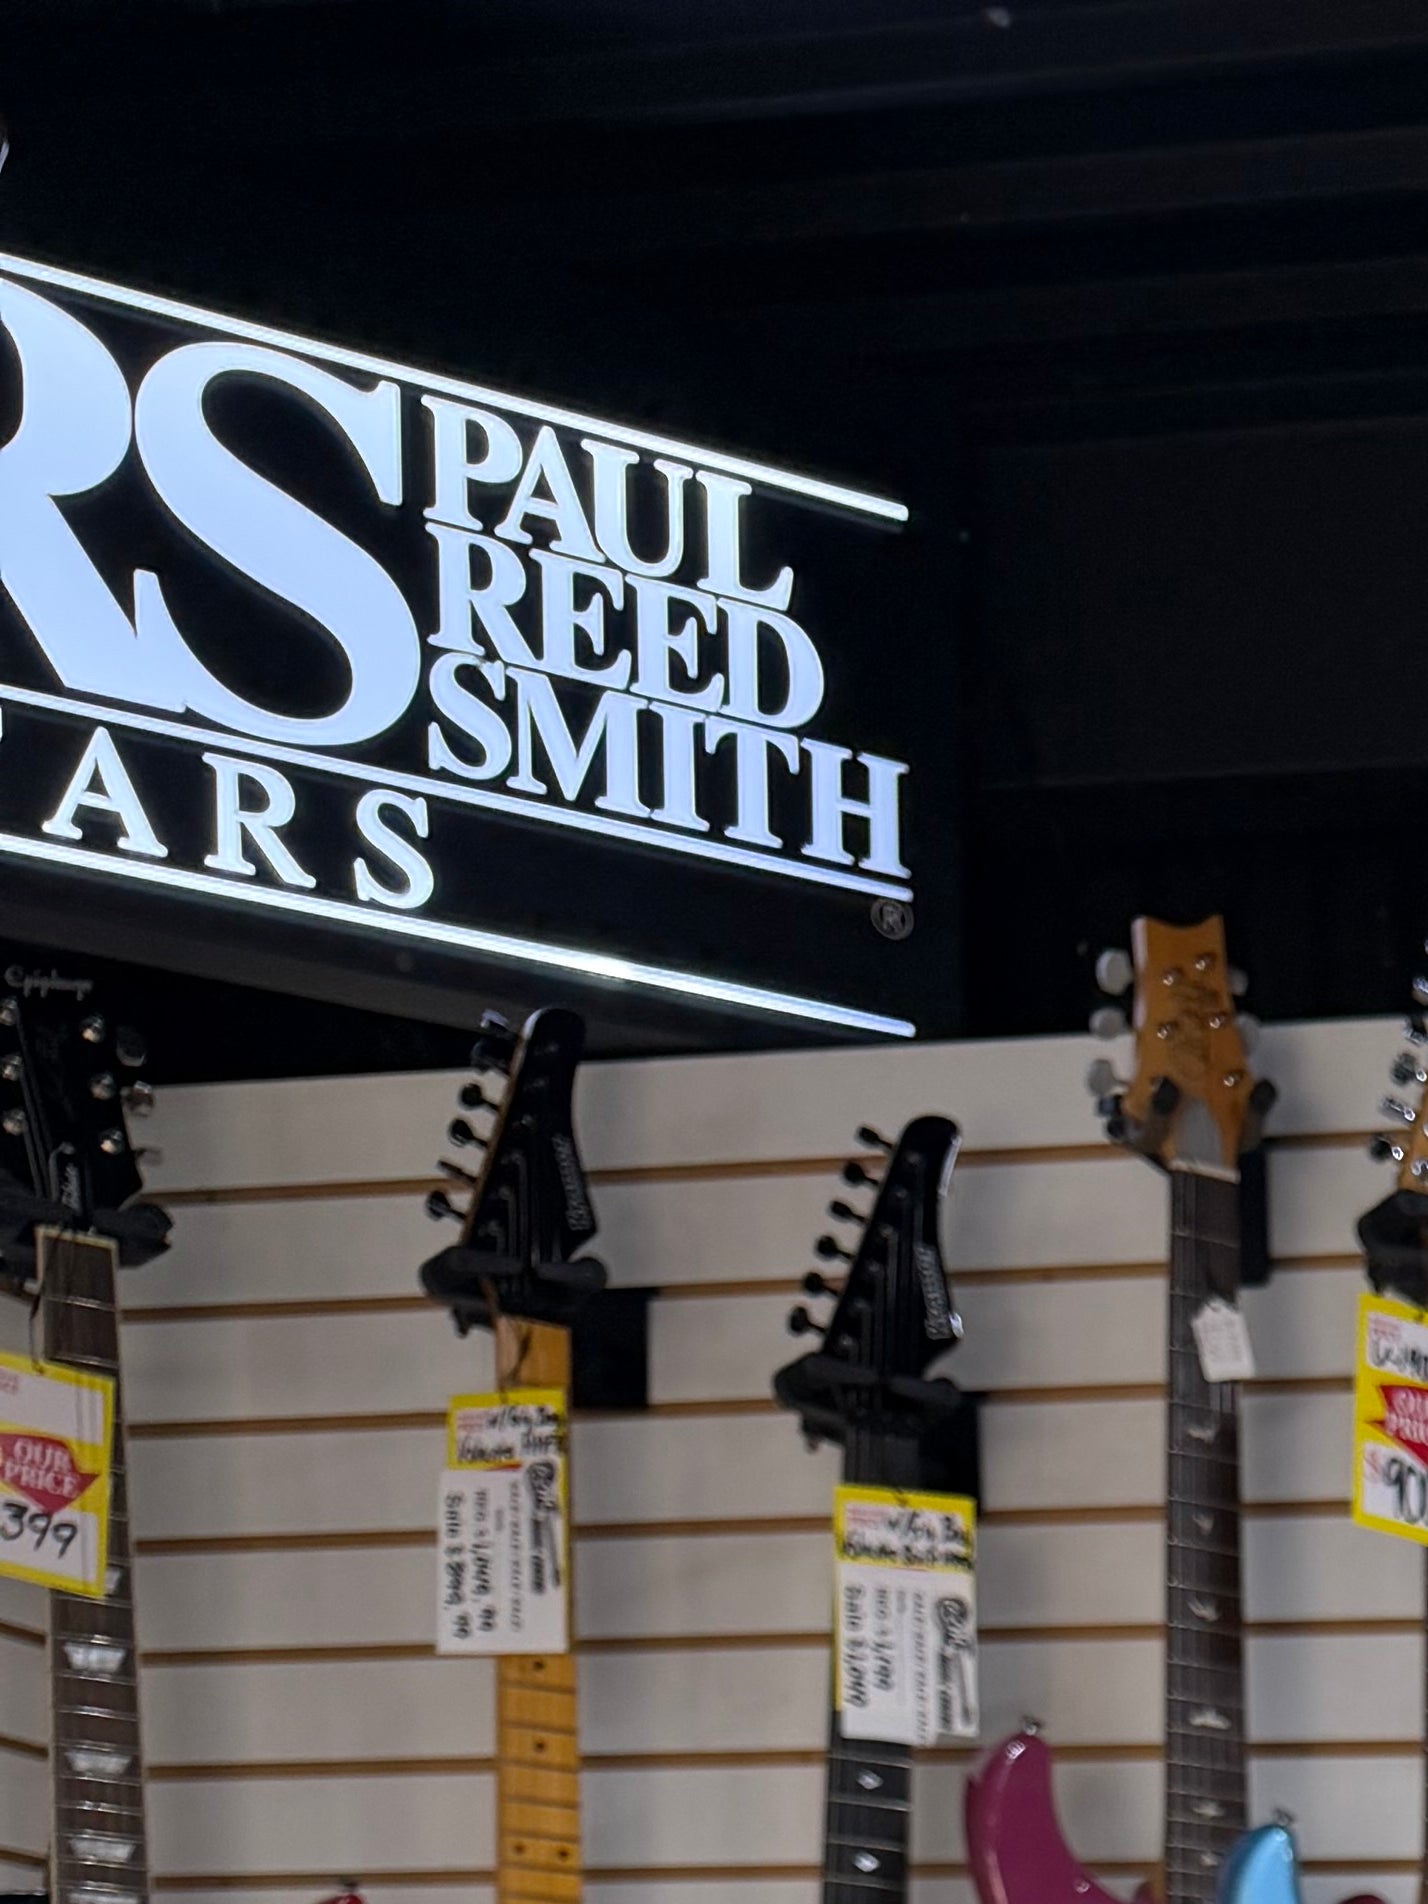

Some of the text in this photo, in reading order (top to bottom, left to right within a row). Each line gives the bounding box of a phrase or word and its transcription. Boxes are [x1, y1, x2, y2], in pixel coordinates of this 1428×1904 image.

[422, 395, 794, 611] PAUL
[425, 522, 824, 728] REED
[0, 706, 434, 910] ARS
[427, 653, 911, 878] SMITH
[3, 1461, 81, 1499] PRICE
[13, 1436, 72, 1474] OUR
